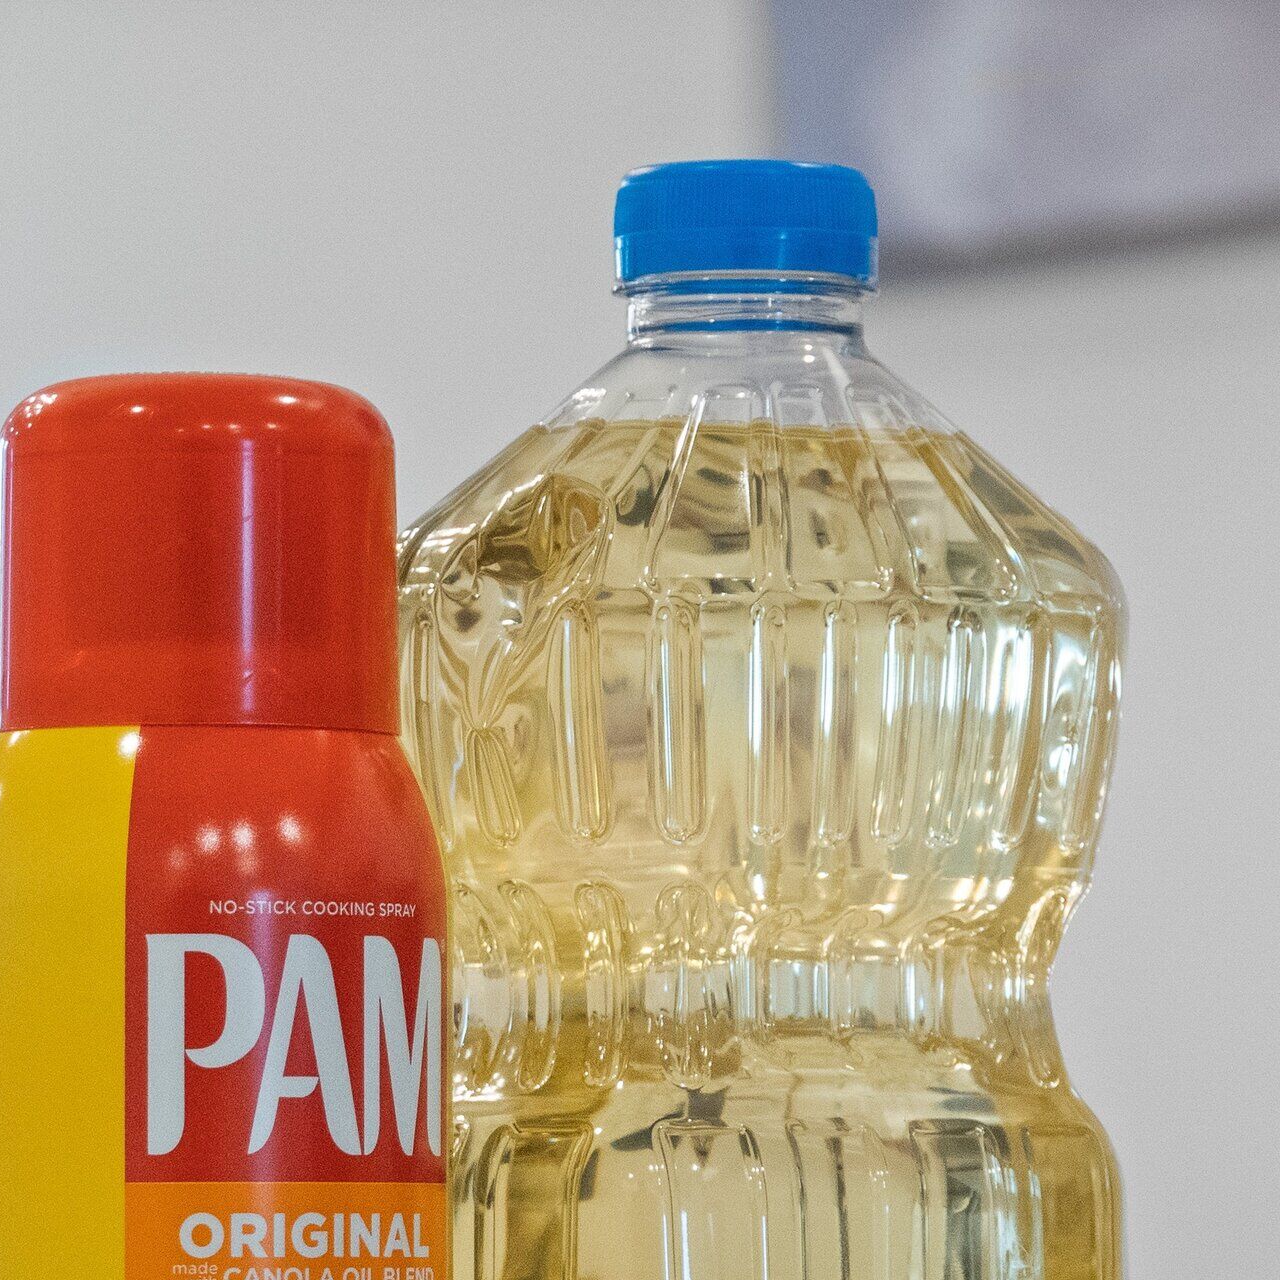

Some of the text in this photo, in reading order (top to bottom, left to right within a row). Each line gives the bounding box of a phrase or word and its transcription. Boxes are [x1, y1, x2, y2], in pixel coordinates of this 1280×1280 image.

[210, 899, 416, 918] NO-STICK COOKING SPRAY
[145, 933, 443, 1157] PAM
[179, 1212, 429, 1259] ORIGINAL
[172, 1262, 218, 1275] made
